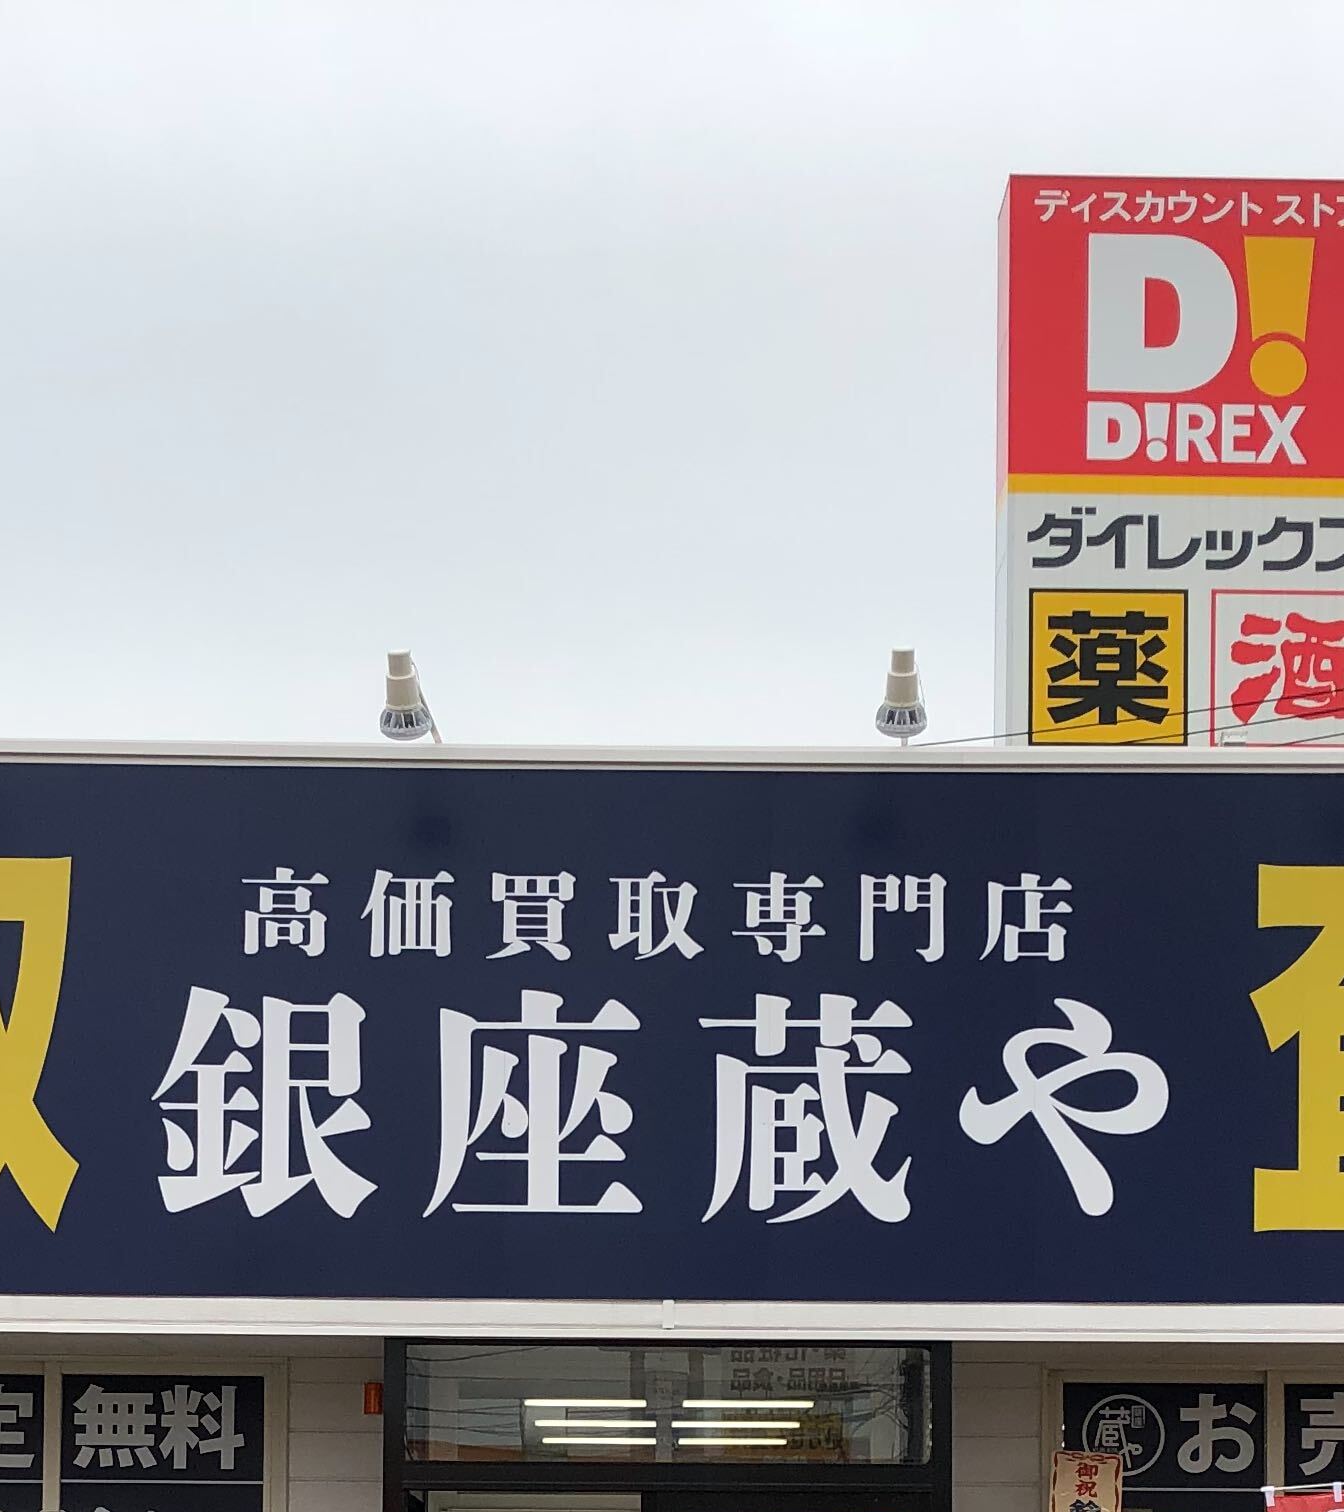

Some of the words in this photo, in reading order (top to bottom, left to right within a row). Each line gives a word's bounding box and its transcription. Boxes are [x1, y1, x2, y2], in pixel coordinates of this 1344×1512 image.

[1034, 190, 1264, 226] ディスカウント
[1086, 232, 1316, 397] D!
[1047, 609, 1170, 726] 薬
[241, 867, 1074, 963] 高価買取専門店
[151, 985, 1170, 1224] 銀座蔵や
[1074, 1462, 1099, 1498] 御祝
